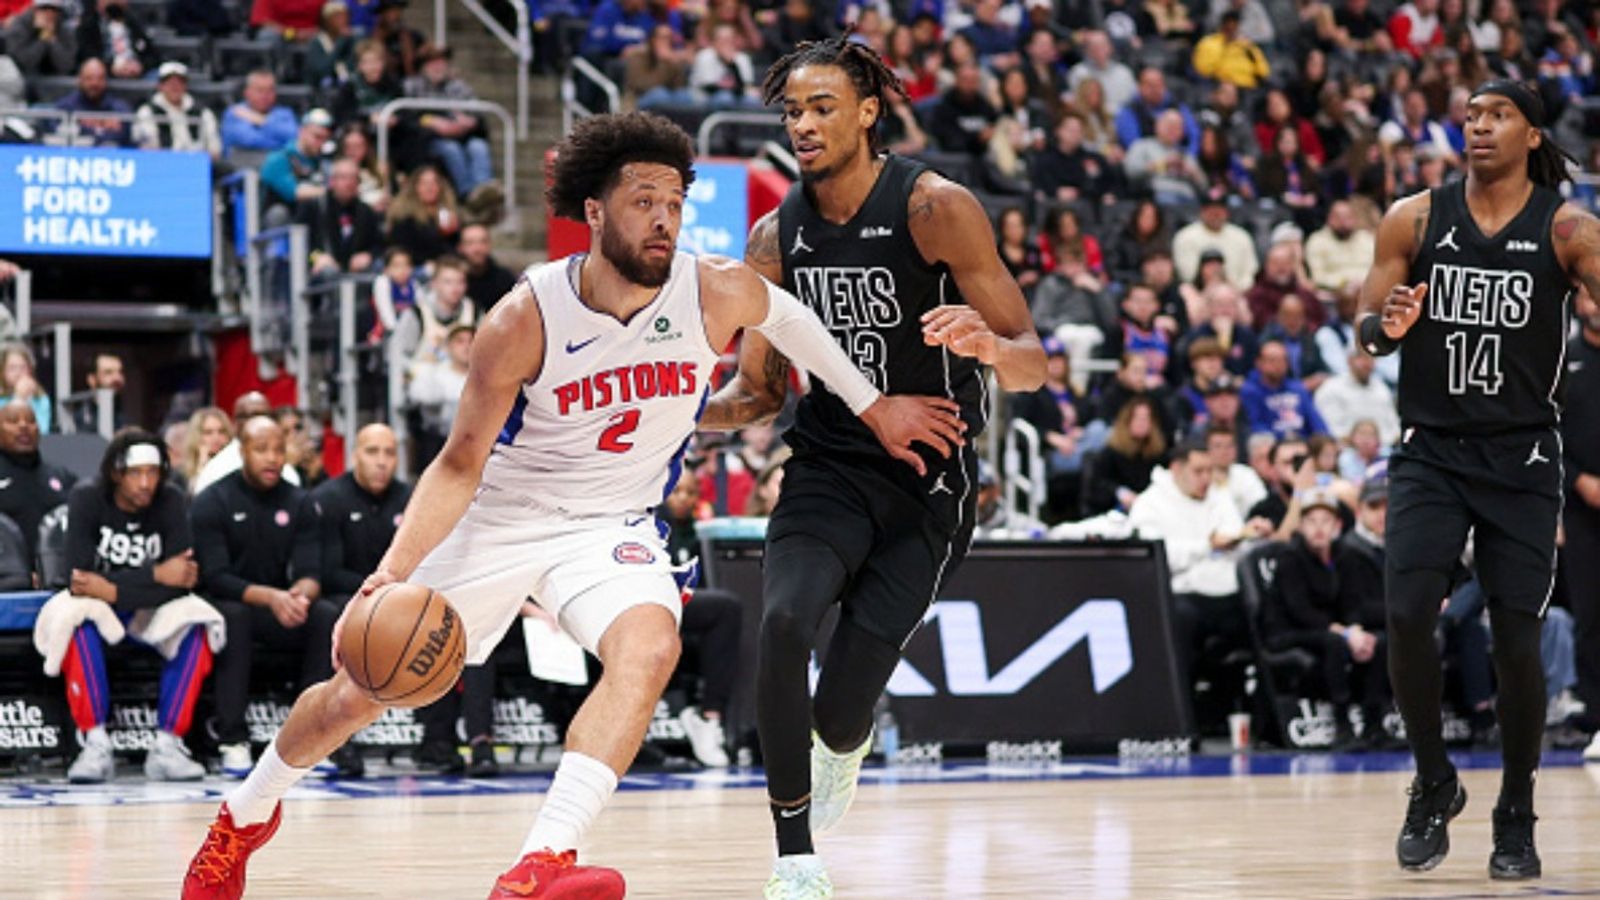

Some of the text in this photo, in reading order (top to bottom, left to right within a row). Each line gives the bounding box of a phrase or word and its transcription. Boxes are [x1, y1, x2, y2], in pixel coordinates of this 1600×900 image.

[17, 156, 136, 187] HENRY
[23, 186, 111, 214] FORD
[23, 216, 156, 246] HEALTH
[794, 267, 902, 329] NETS
[1430, 264, 1533, 327] NETS
[1446, 331, 1504, 394] 14
[553, 361, 698, 415] PISTONS
[597, 408, 641, 453] 2
[407, 604, 453, 677] Wilson
[0, 700, 43, 727] ttle
[0, 726, 59, 748] sars
